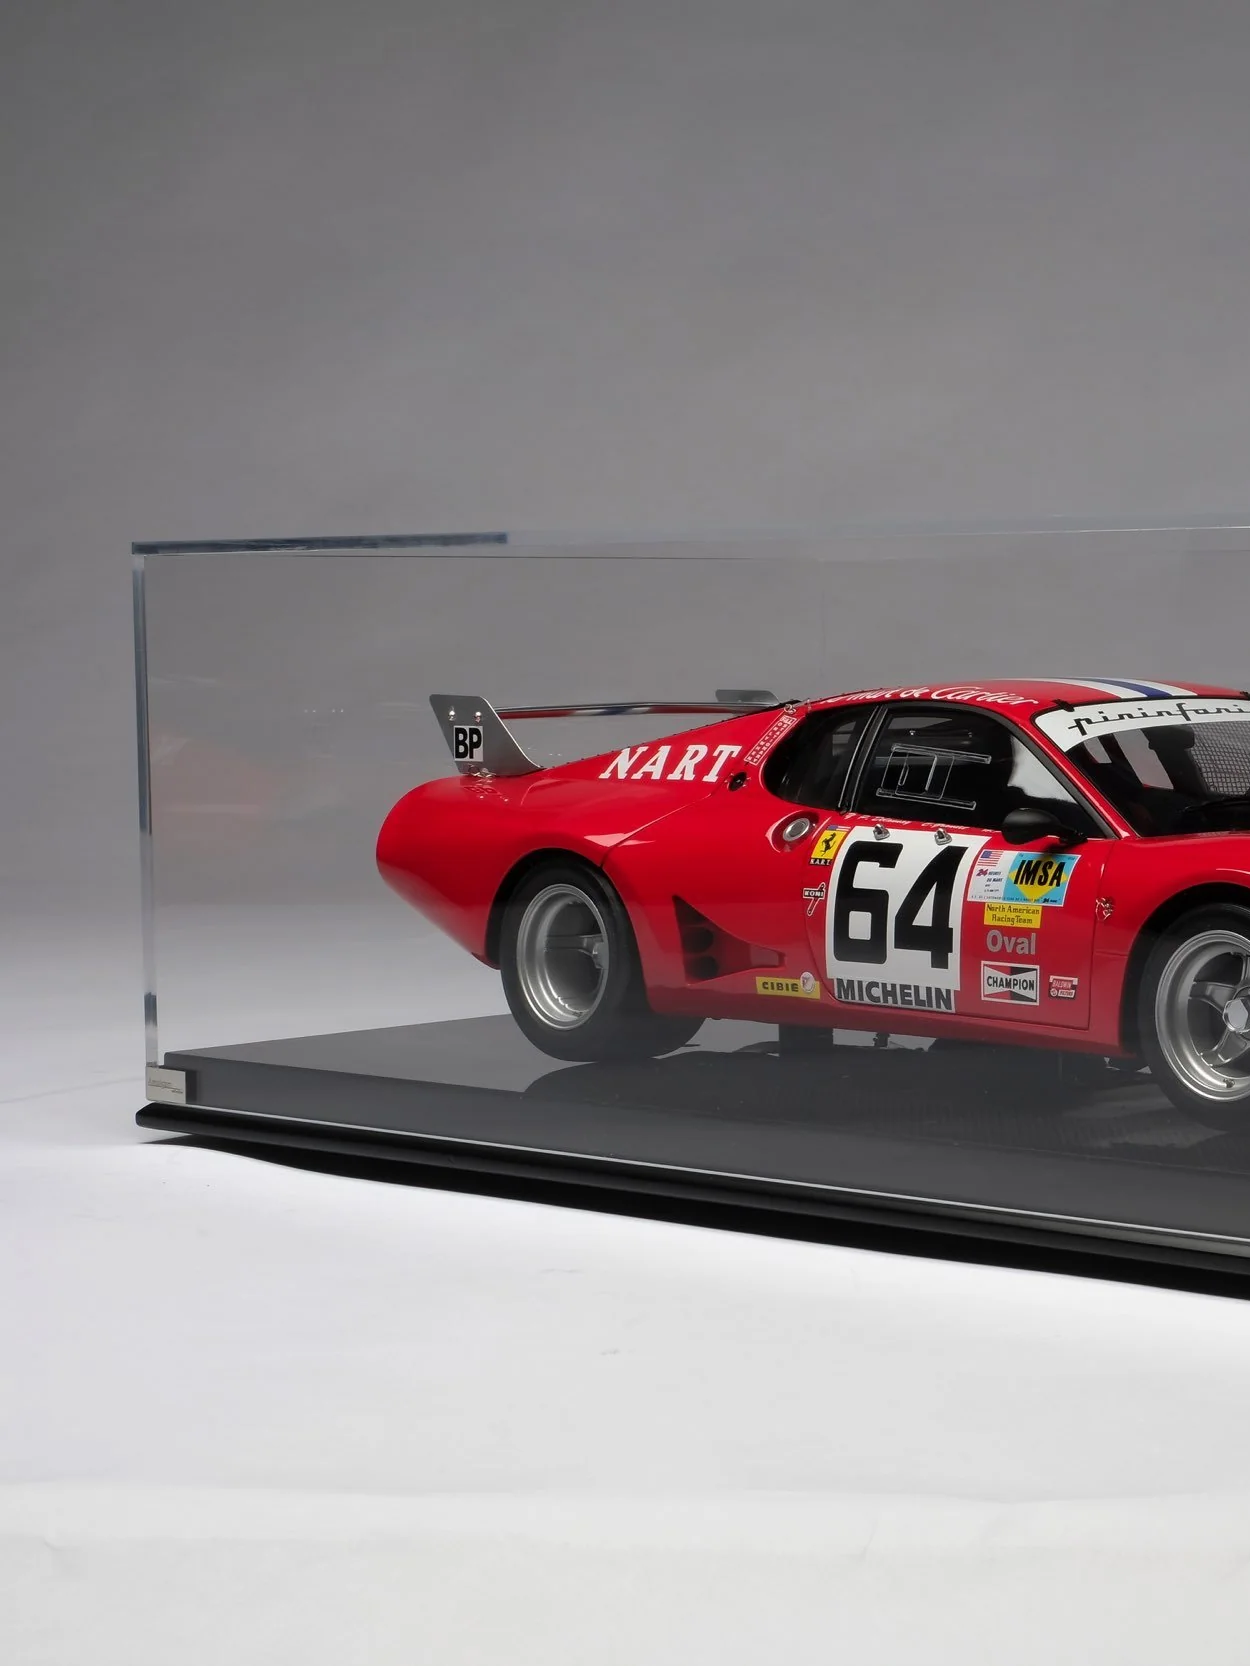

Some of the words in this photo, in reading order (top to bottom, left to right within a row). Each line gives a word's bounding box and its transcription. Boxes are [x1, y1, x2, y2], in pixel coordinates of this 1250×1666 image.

[931, 686, 1039, 705] Cartier
[455, 727, 482, 759] BP
[598, 744, 742, 783] NART
[1013, 859, 1066, 887] IMSA
[833, 840, 970, 970] 64
[986, 903, 1006, 913] North
[1007, 904, 1040, 915] American
[991, 913, 1015, 925] Racing
[1016, 914, 1033, 924] Team
[986, 929, 1037, 955] Oval
[762, 981, 799, 992] CIBIE
[836, 978, 952, 1010] MICHELIN
[986, 975, 1035, 991] CHAMPION
